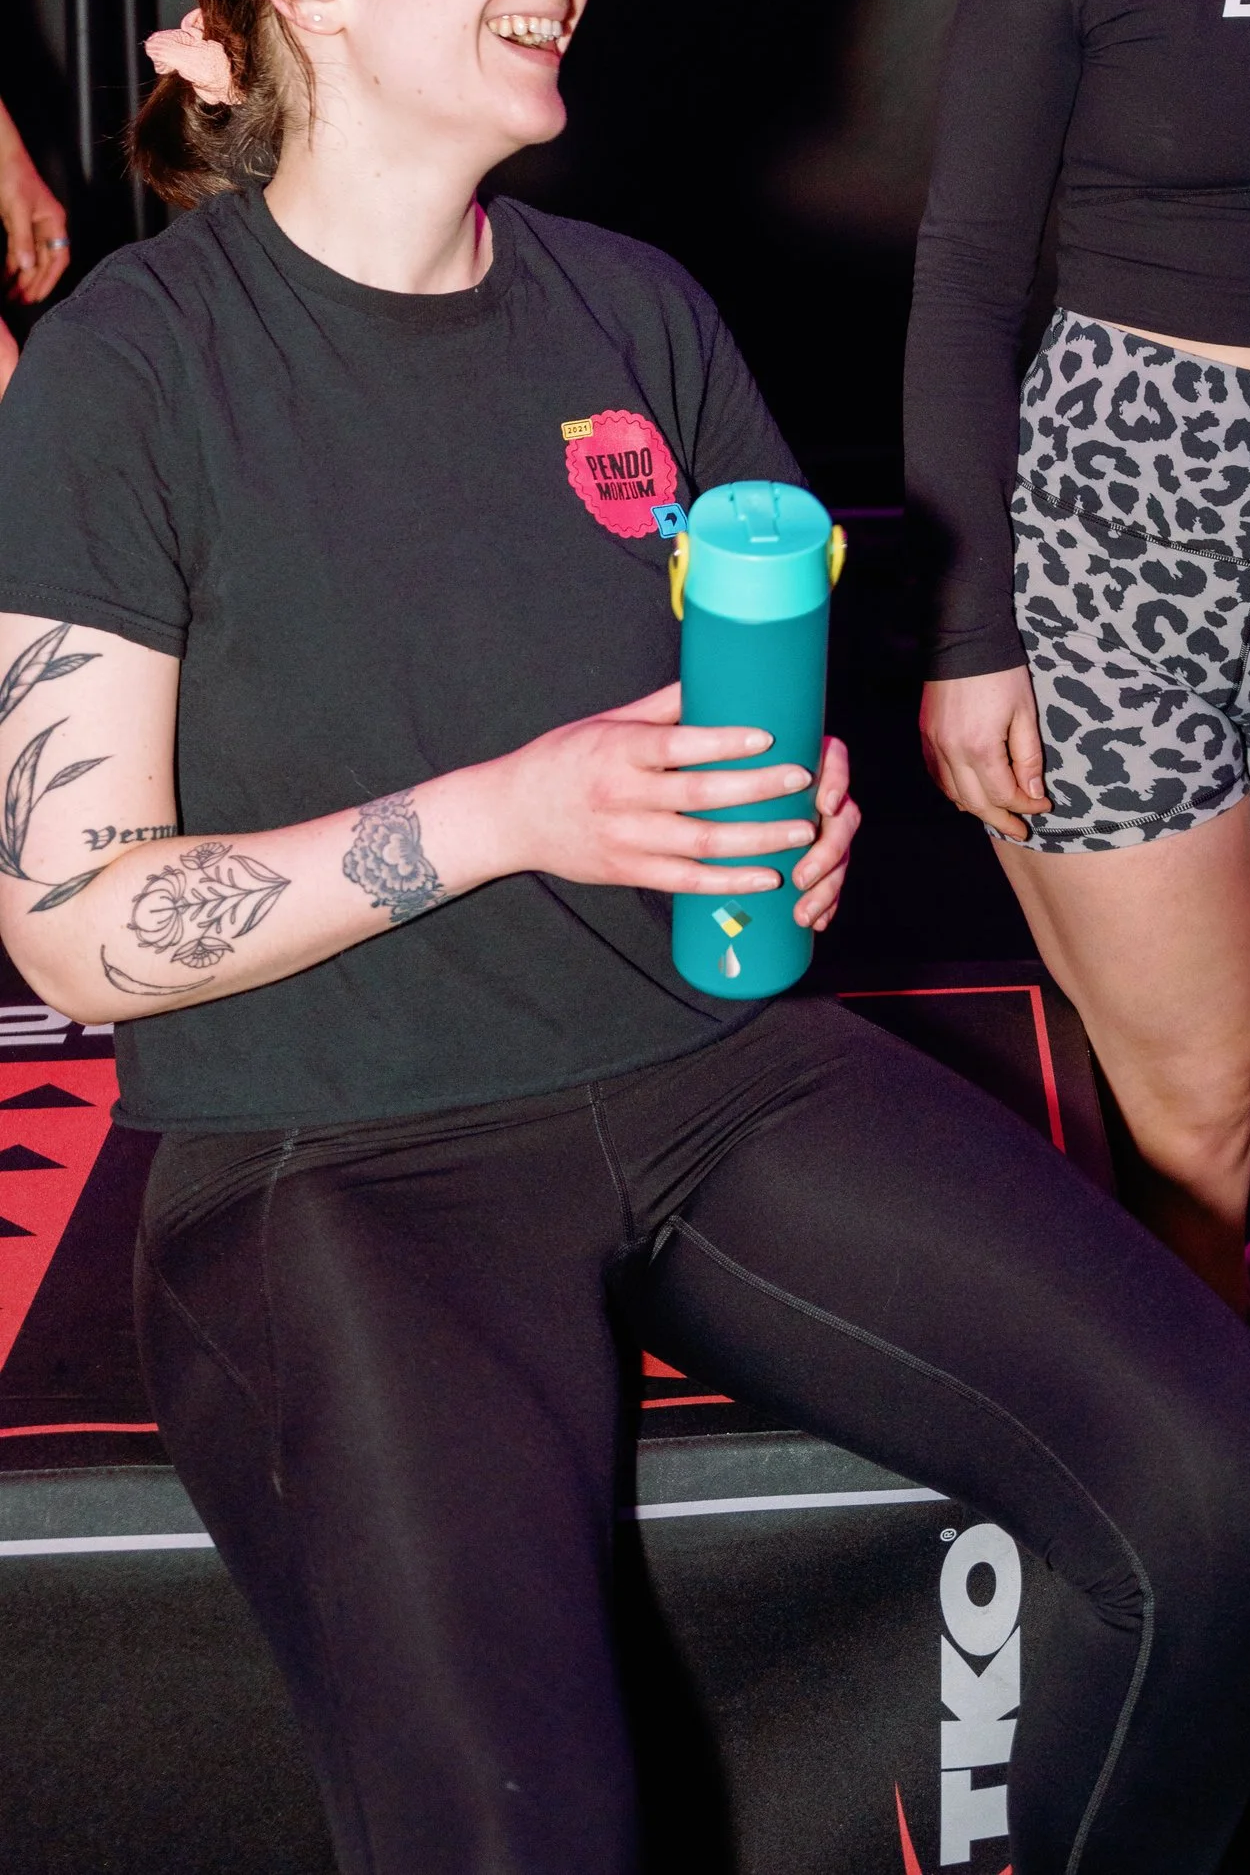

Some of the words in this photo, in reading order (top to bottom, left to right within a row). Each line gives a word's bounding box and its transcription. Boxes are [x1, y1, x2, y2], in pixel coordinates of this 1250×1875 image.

[568, 425, 588, 434] 2021
[585, 447, 653, 480] PENDO
[595, 479, 656, 501] MONIUM
[82, 825, 178, 851] Verm
[940, 1523, 1022, 1866] TKO
